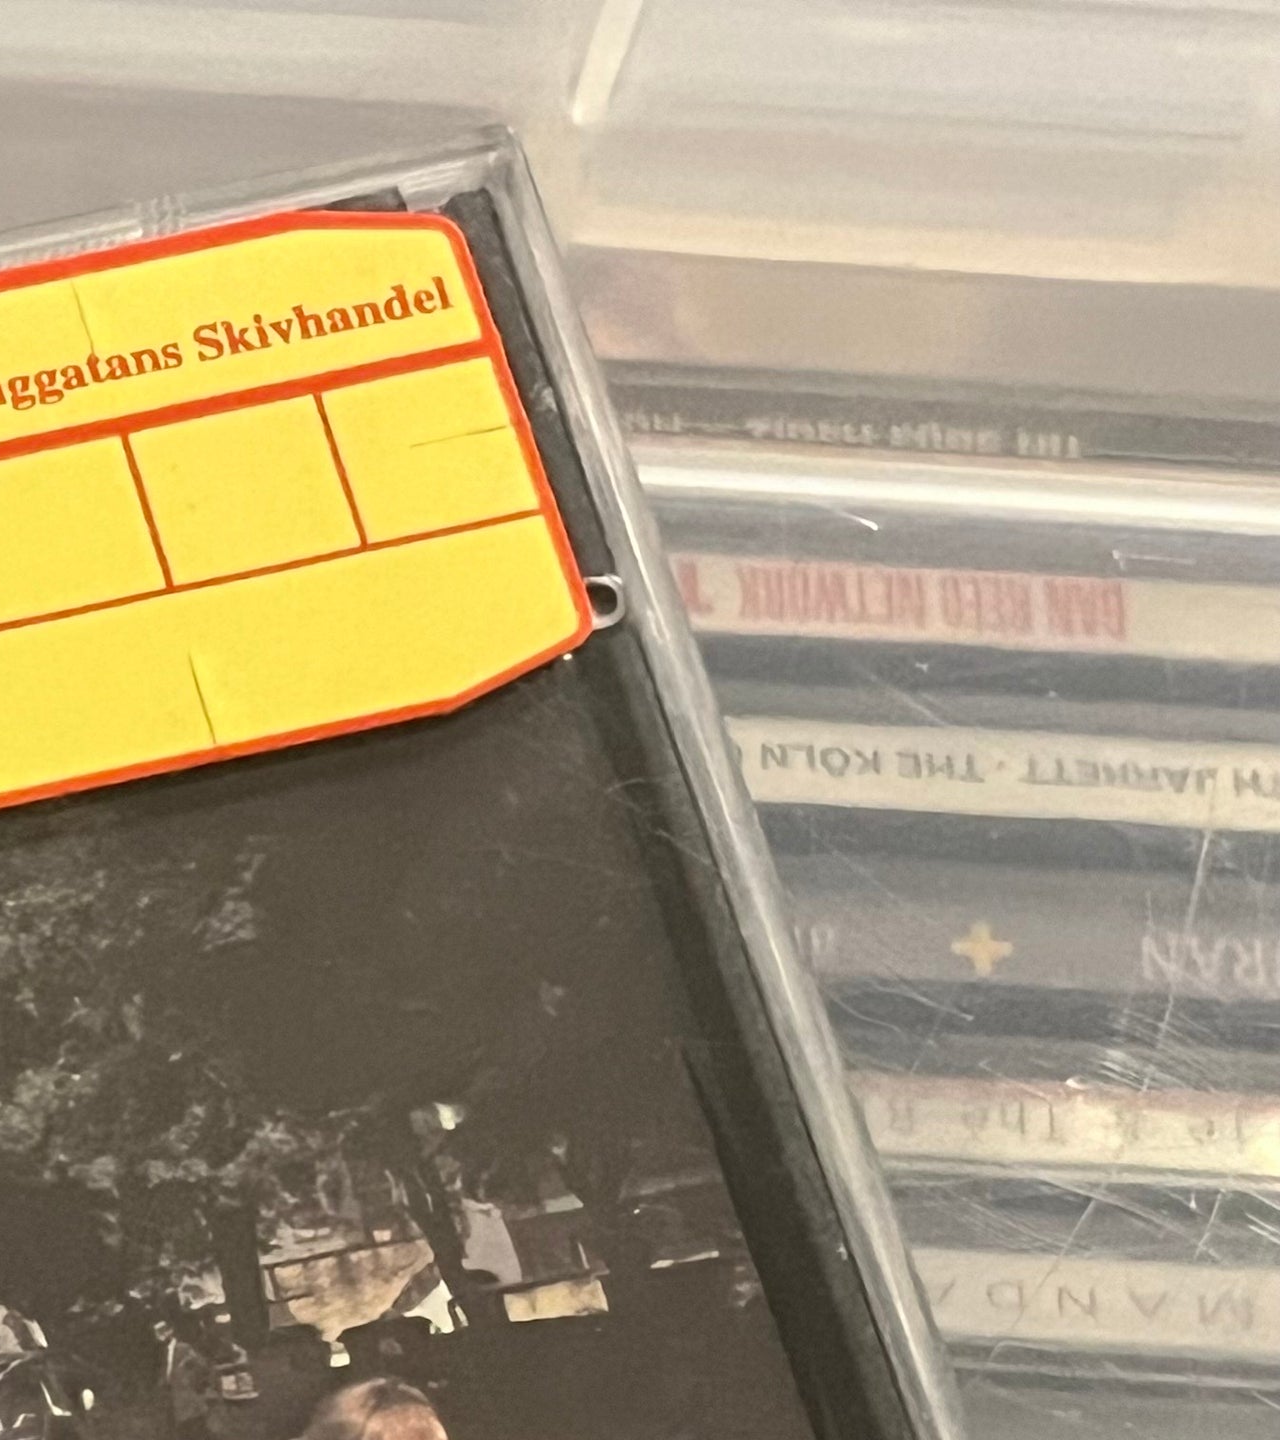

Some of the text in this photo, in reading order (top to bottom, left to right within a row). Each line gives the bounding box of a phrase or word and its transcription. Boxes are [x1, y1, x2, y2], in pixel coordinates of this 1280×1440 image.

[196, 274, 454, 363] Skivhandel
[761, 742, 880, 777] KÖLN
[899, 753, 984, 783] THE
[1021, 758, 1216, 792] JARRETT
